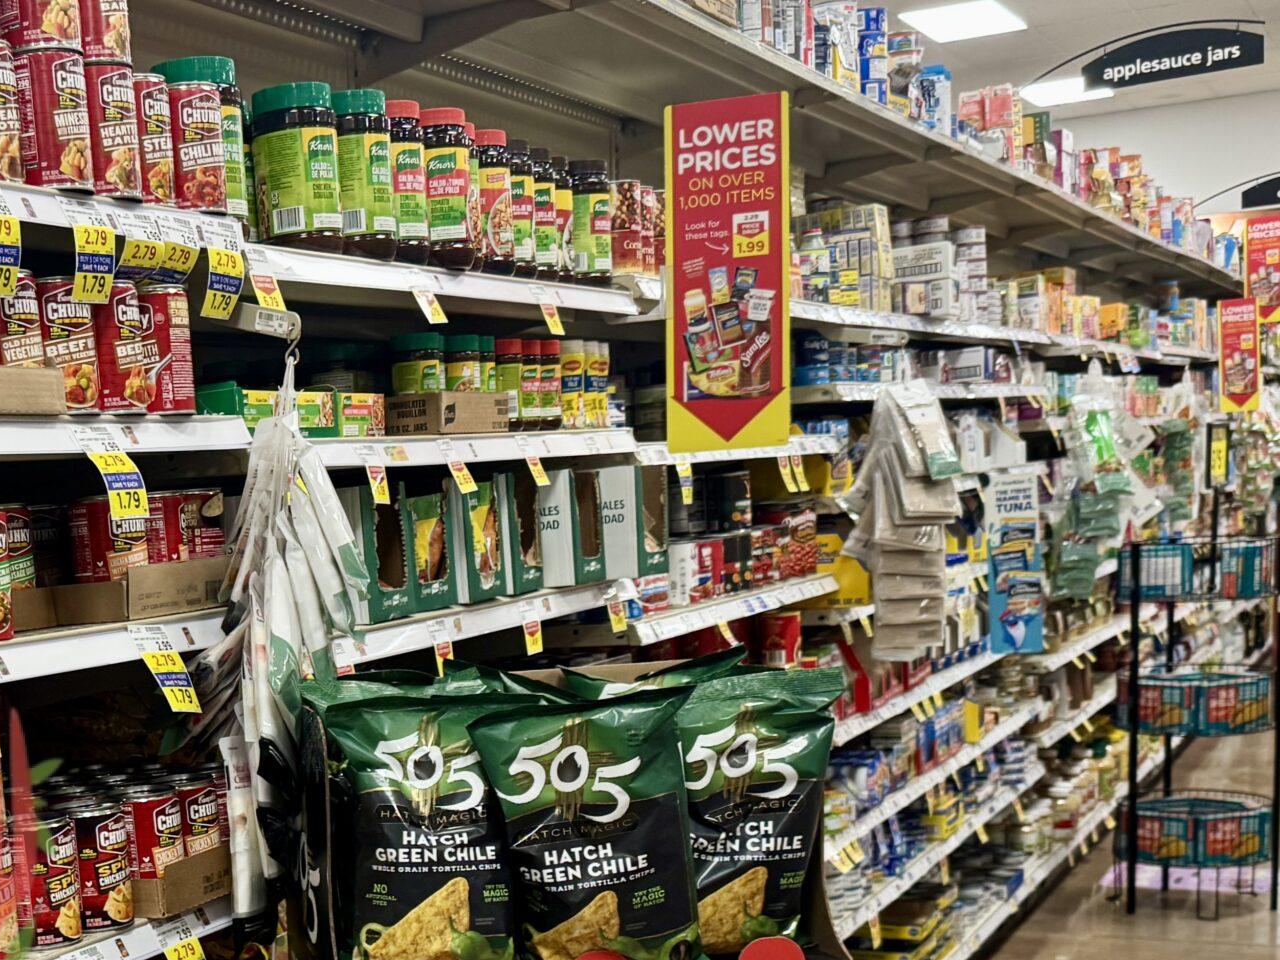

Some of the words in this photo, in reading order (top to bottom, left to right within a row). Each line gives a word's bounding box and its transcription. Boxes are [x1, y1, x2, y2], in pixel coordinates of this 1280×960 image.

[1103, 52, 1203, 81] applesauce
[1207, 45, 1241, 64] jars
[678, 120, 774, 148] LOWER
[426, 159, 456, 172] Knorr
[677, 144, 776, 174] PRICES
[688, 178, 714, 191] ON
[719, 172, 764, 188] OVER
[680, 193, 721, 210] 1,000
[726, 188, 774, 205] ITEMS
[685, 222, 705, 230] Look
[705, 219, 720, 228] for
[685, 231, 707, 240] these
[737, 240, 765, 254] 1.99
[1221, 305, 1255, 314] LOWER
[1221, 312, 1255, 323] PRICES
[685, 724, 801, 799] 505
[375, 731, 486, 812] 505
[497, 731, 641, 824] 505
[402, 830, 469, 847] HATCH
[375, 846, 436, 863] GREEN
[443, 845, 497, 863] CHILE
[544, 843, 614, 865] HATCH
[398, 864, 427, 872] GRAIN
[430, 863, 473, 872] TORTILLA
[475, 862, 501, 871] CHIPS
[519, 861, 581, 884] GREEN
[585, 853, 649, 878] CHILE
[173, 943, 196, 960] 2.79
